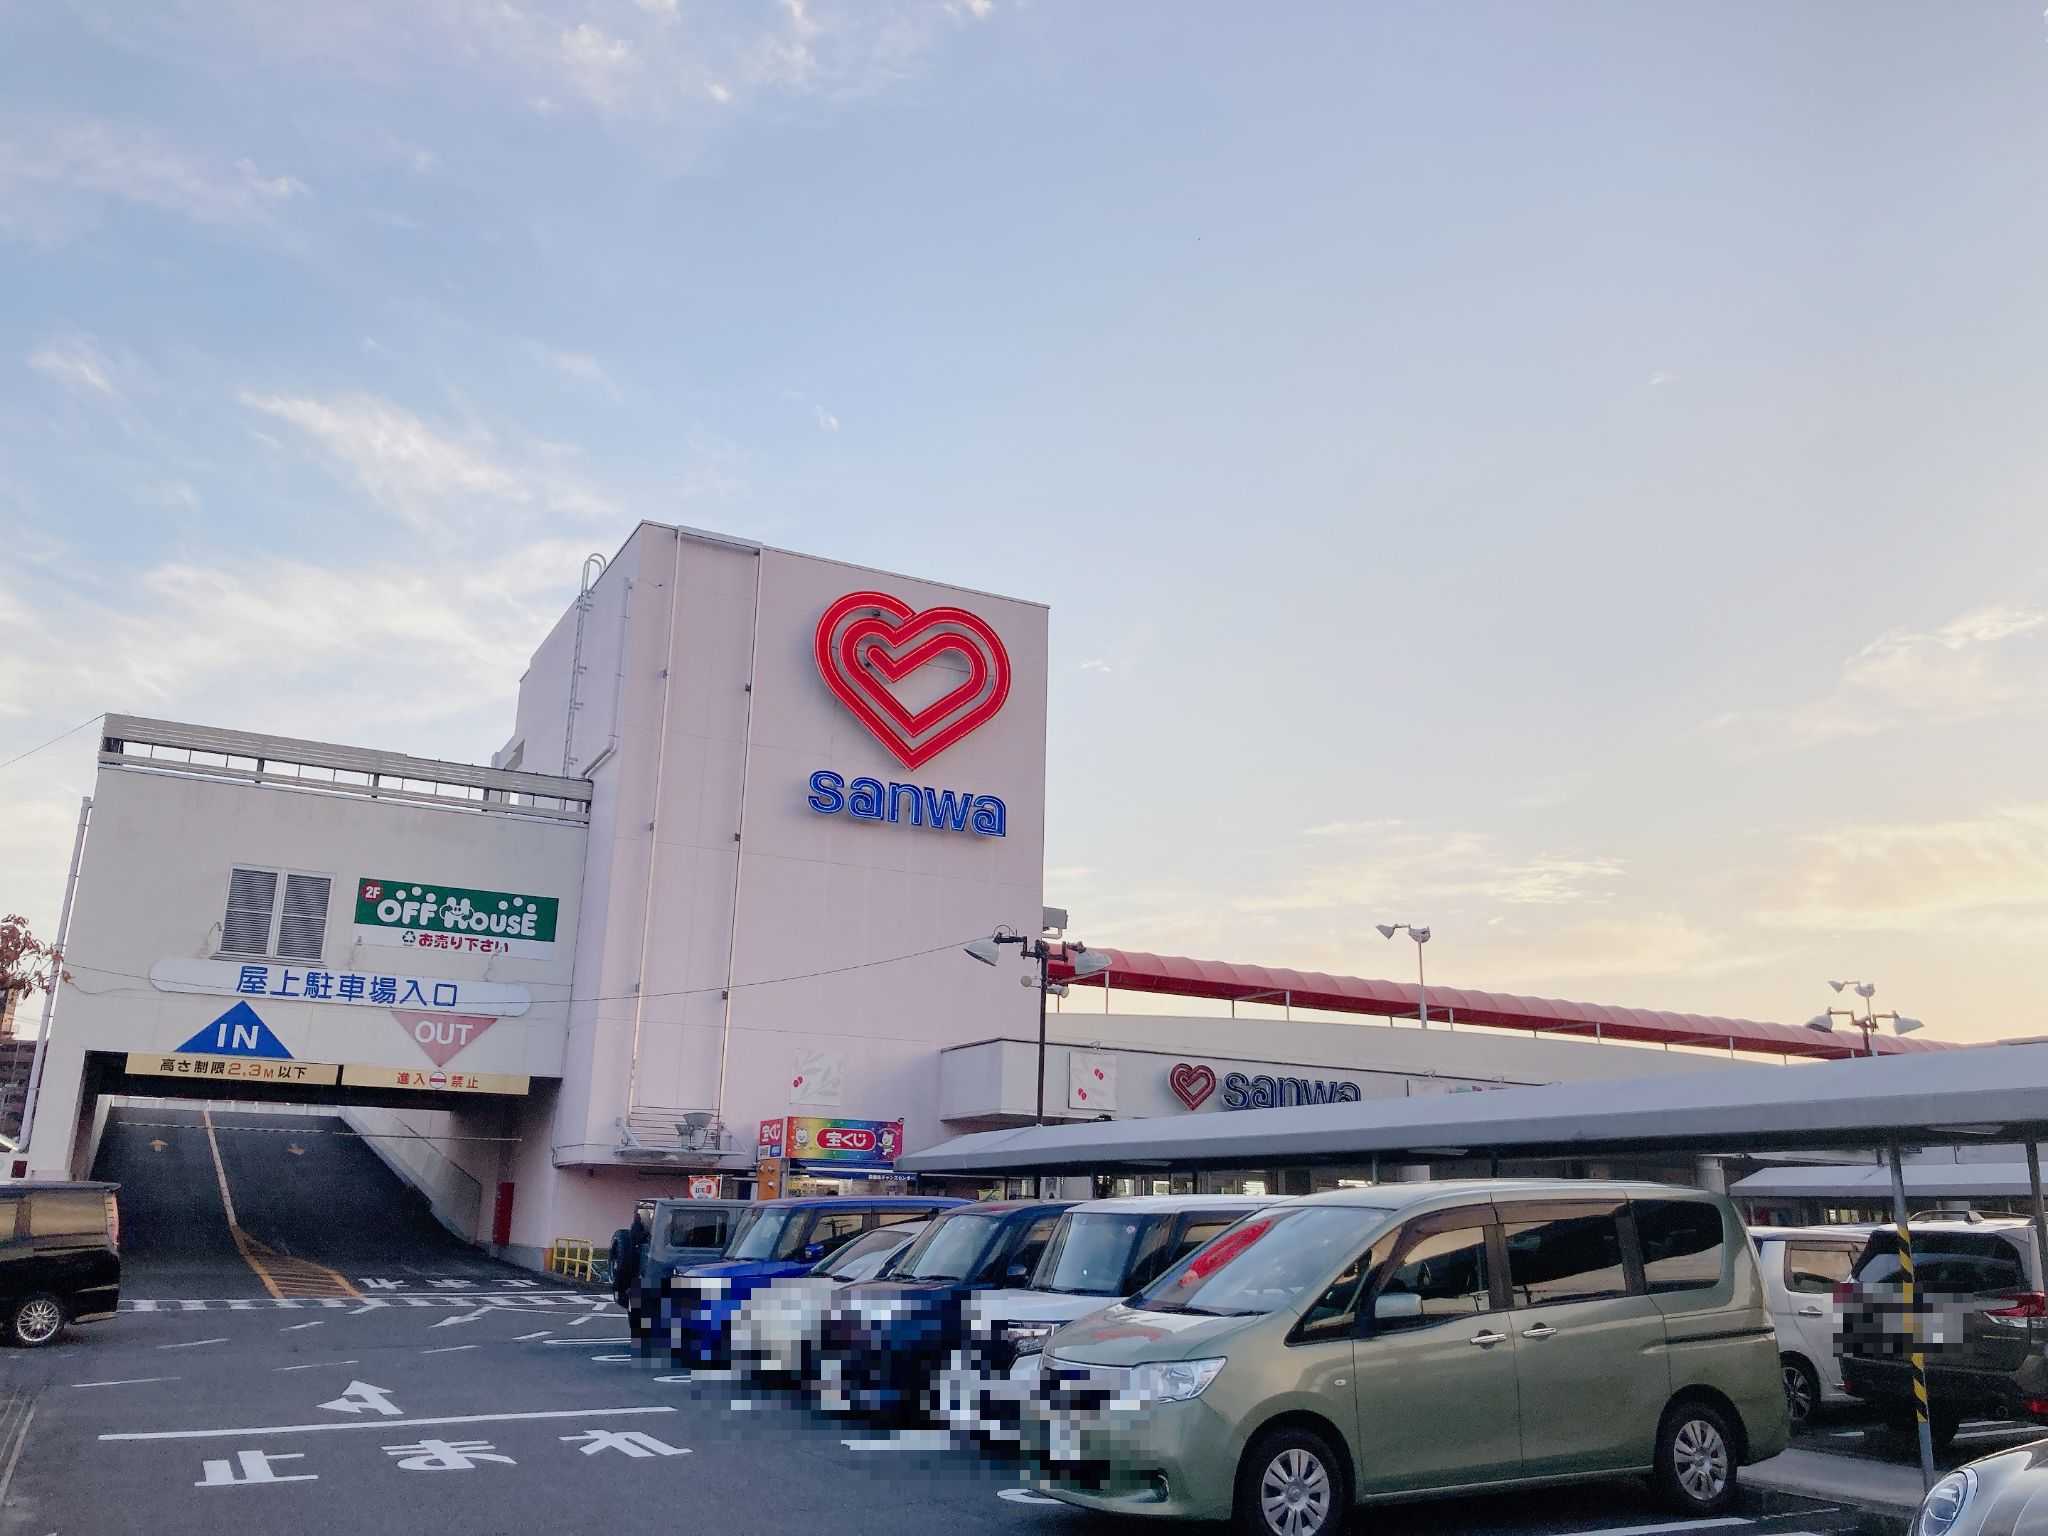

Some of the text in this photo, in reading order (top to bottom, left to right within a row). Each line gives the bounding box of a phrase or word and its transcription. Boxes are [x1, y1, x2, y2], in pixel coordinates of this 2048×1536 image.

[808, 770, 1006, 837] sanwa
[364, 885, 381, 899] 2F
[376, 891, 538, 937] OFF HOUSE
[418, 932, 509, 953] お売り下さい
[236, 966, 458, 1007] 屋上駐車場入口
[216, 1023, 260, 1050] IN
[414, 1019, 474, 1047] OUT
[761, 1122, 781, 1143] 宝くじ
[825, 1131, 867, 1148] 宝くじ
